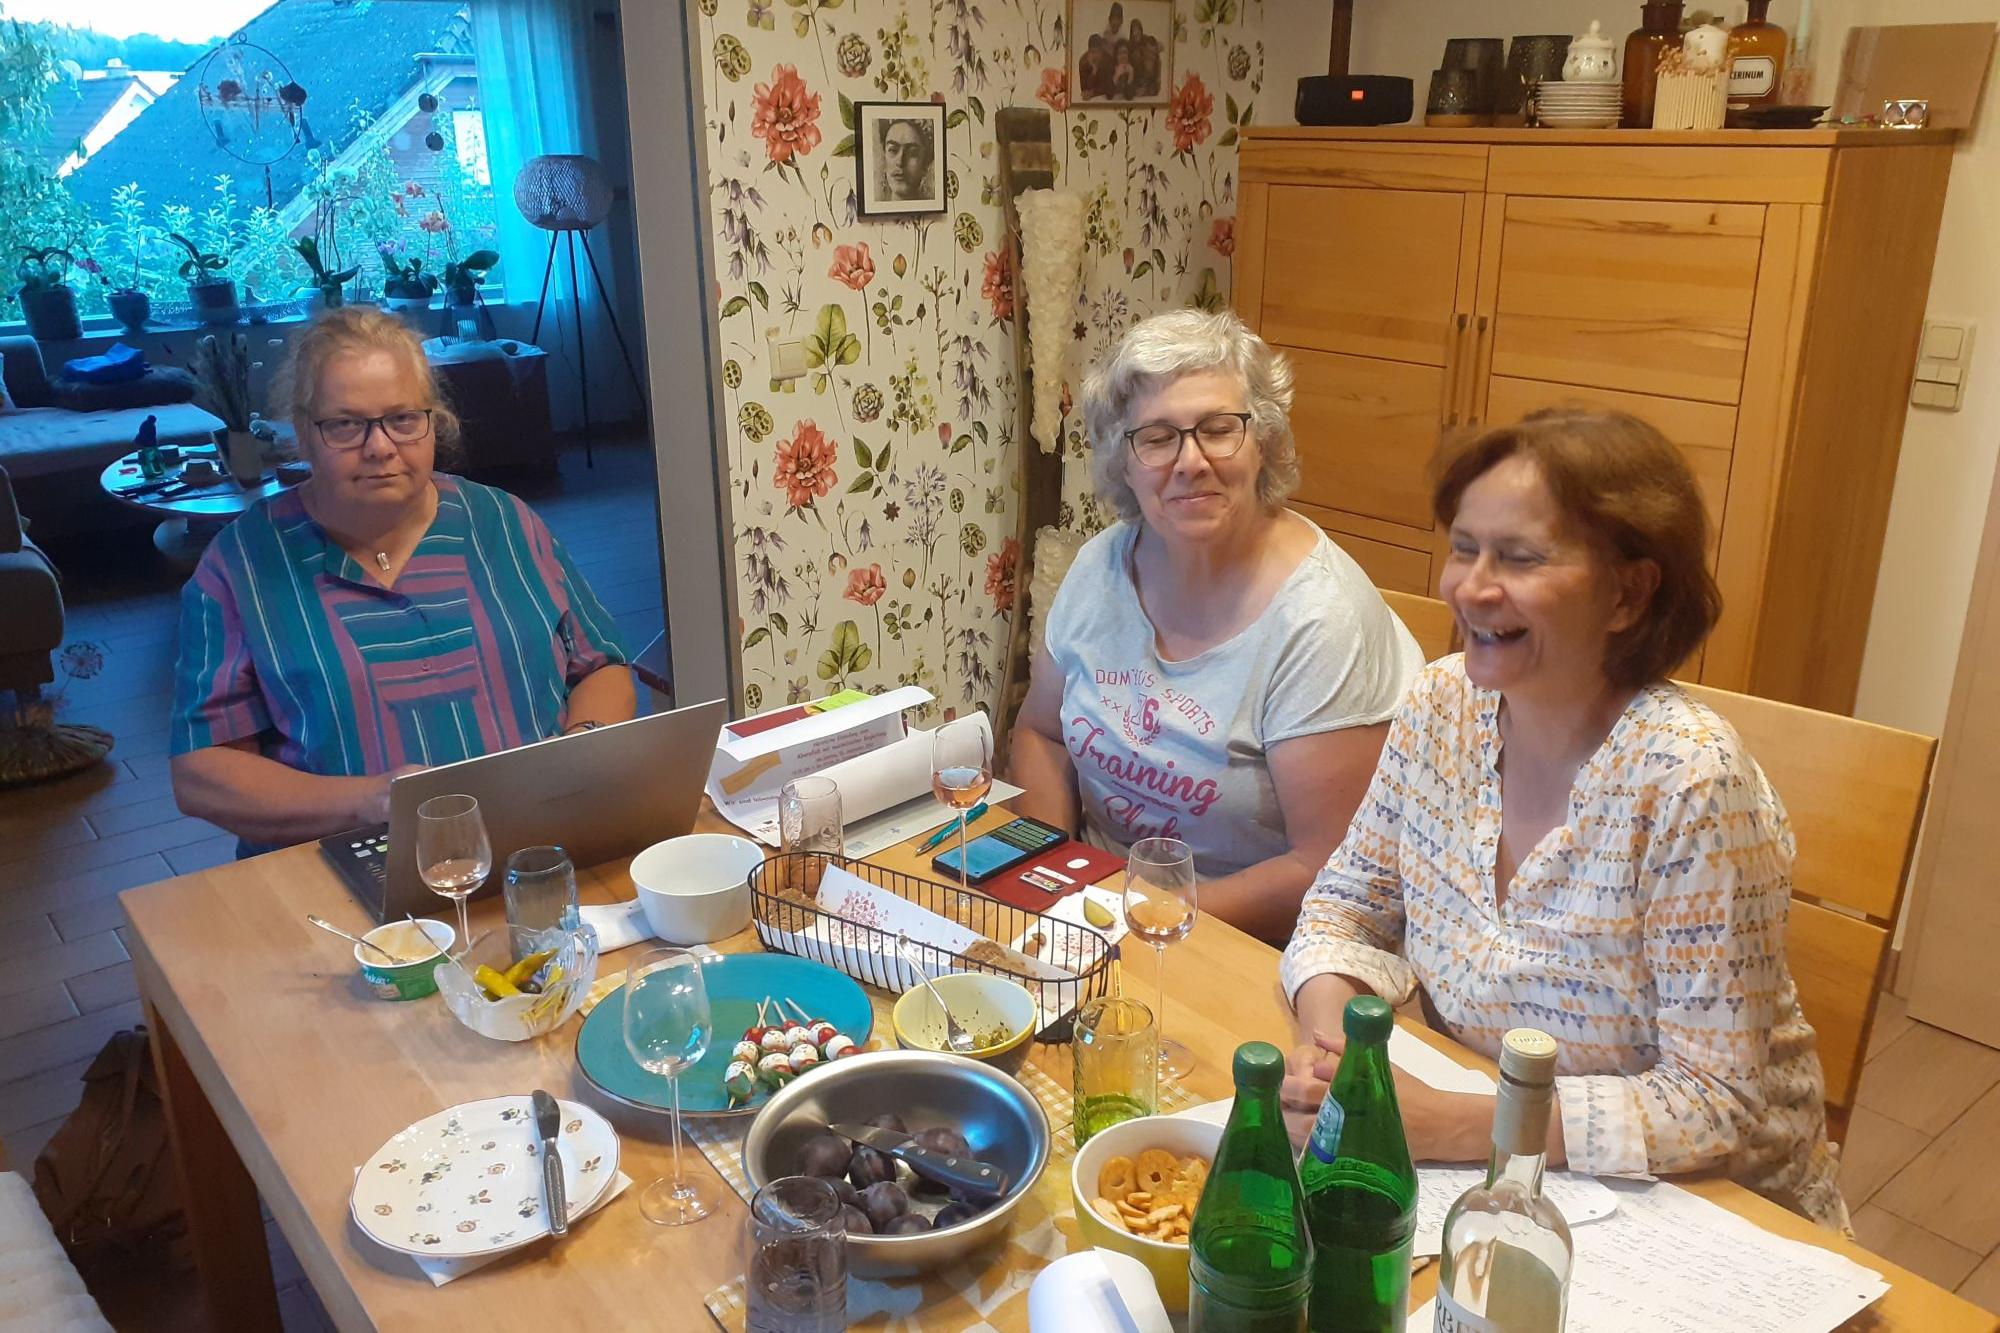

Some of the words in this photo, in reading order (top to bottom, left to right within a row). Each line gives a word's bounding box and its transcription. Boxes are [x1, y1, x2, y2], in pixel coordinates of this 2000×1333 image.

[1730, 70, 1764, 80] CERINUM
[1161, 688, 1216, 736] SPORTS
[1070, 717, 1223, 817] Training
